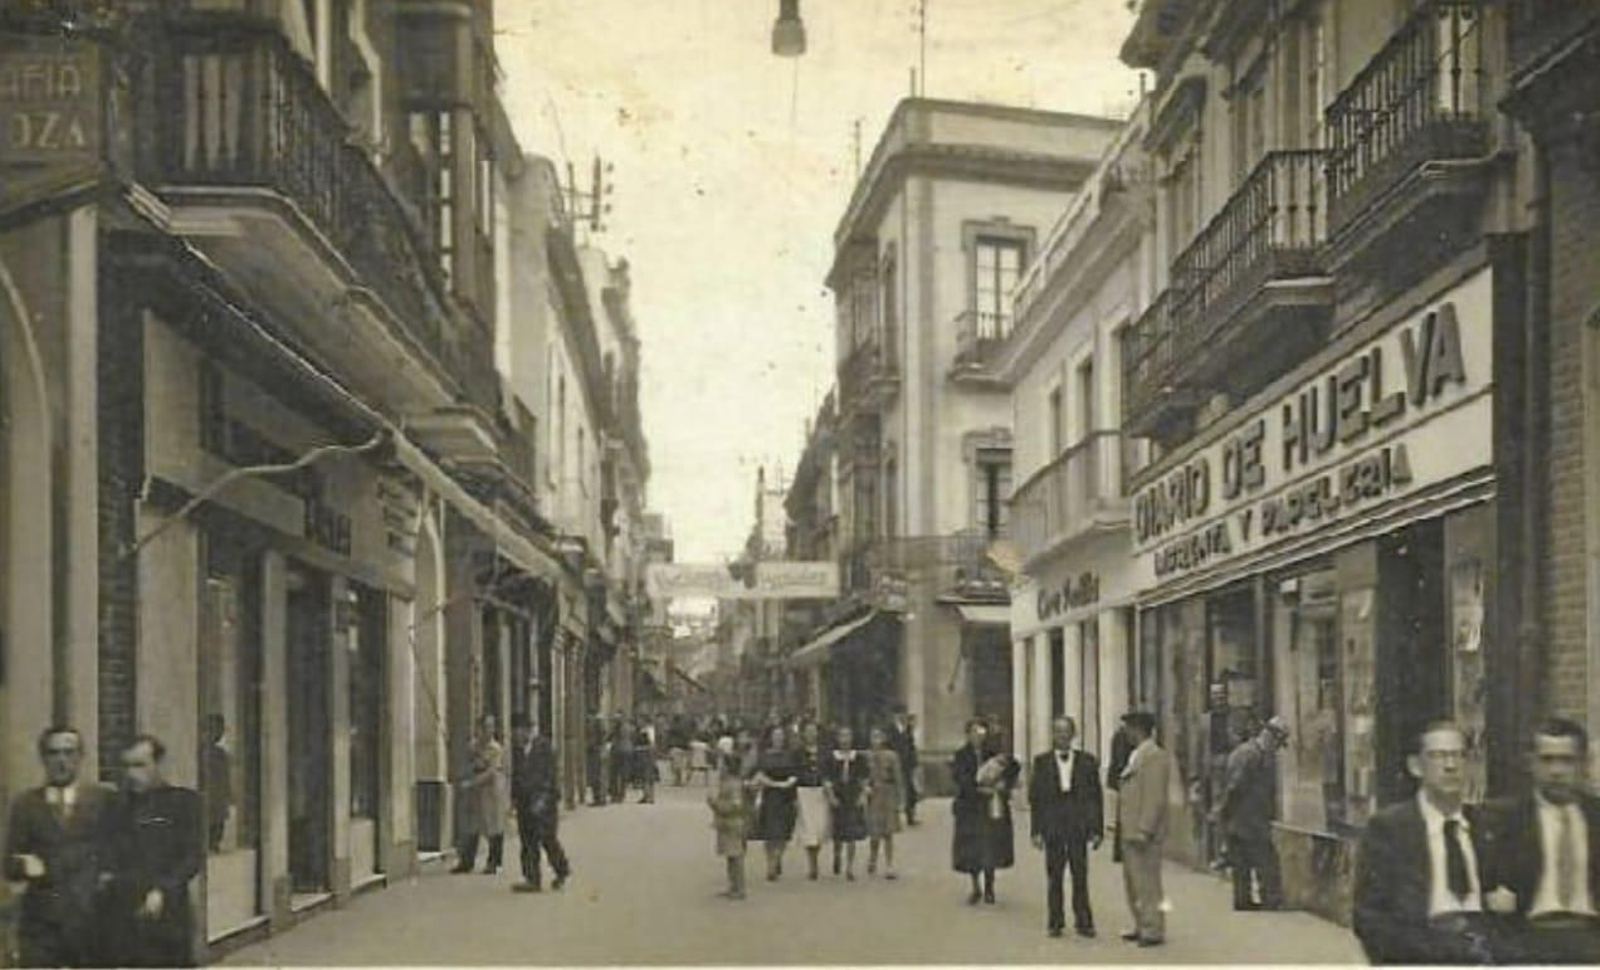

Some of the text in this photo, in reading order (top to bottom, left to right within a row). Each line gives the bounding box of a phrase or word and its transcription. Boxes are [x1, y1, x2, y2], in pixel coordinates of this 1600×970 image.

[1134, 300, 1467, 544] DIARIO DE HUELVA
[1236, 508, 1253, 542] Y
[1260, 442, 1413, 537] PAPELERIA
